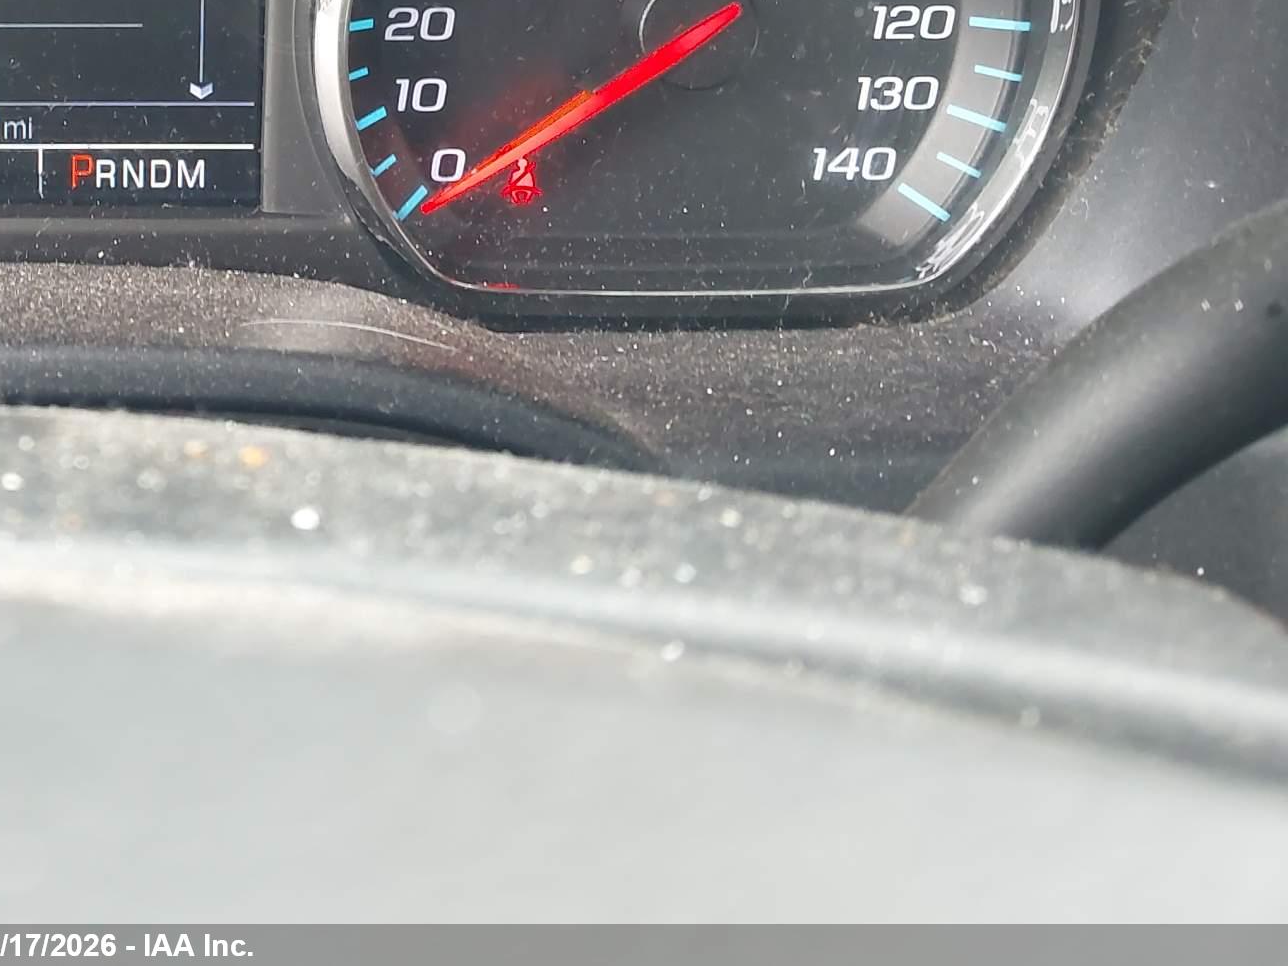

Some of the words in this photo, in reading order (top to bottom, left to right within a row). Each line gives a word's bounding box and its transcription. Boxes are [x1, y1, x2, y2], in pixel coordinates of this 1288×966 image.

[384, 7, 456, 41] 20
[873, 5, 956, 40] 120
[395, 78, 448, 112] 10
[857, 76, 939, 112] 130
[430, 148, 466, 182] 0
[813, 146, 897, 182] 140
